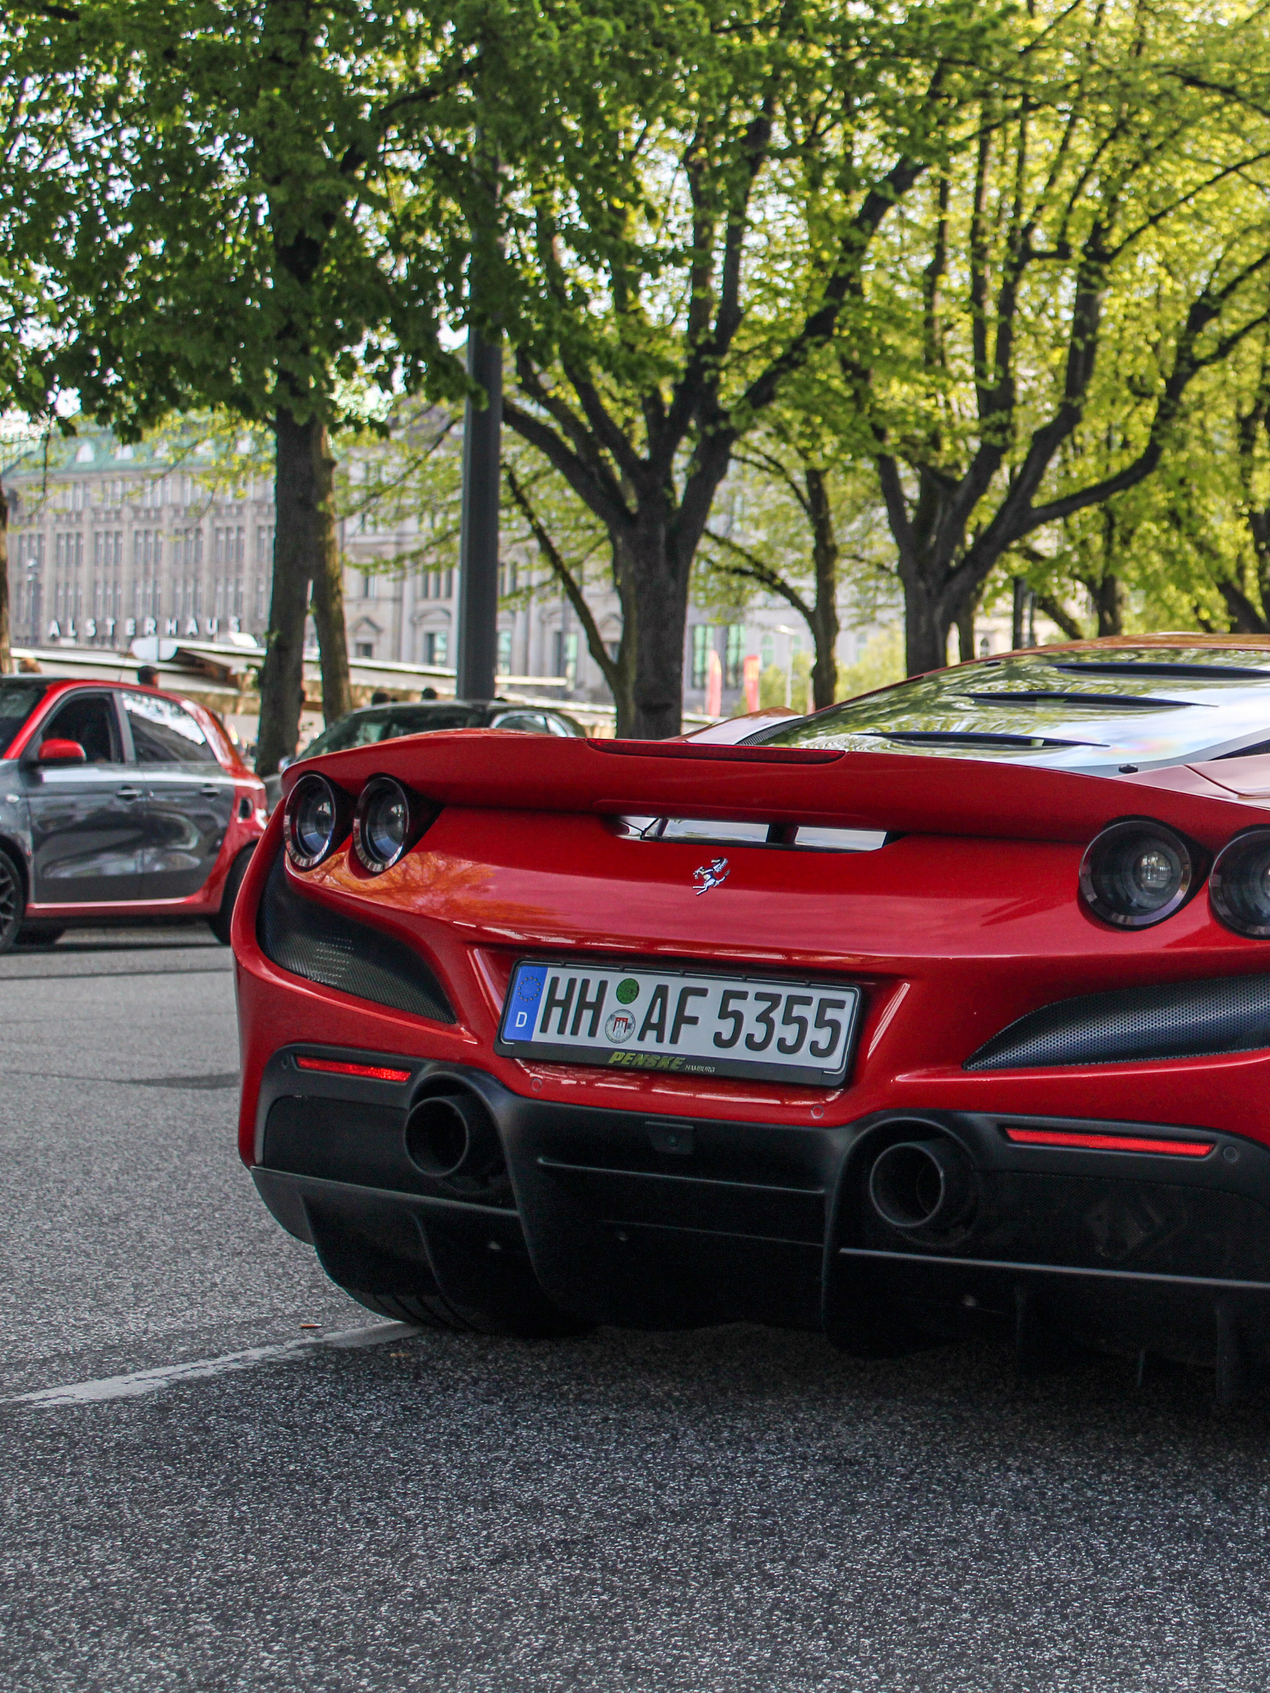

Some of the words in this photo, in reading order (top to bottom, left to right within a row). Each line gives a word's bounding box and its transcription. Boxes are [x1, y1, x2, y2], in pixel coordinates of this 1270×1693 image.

[49, 616, 240, 637] ALSTERHAUS
[515, 1011, 528, 1028] D
[539, 976, 609, 1038] HH
[637, 984, 709, 1045] AF
[713, 989, 847, 1058] 5355
[608, 1051, 686, 1070] PENSKE
